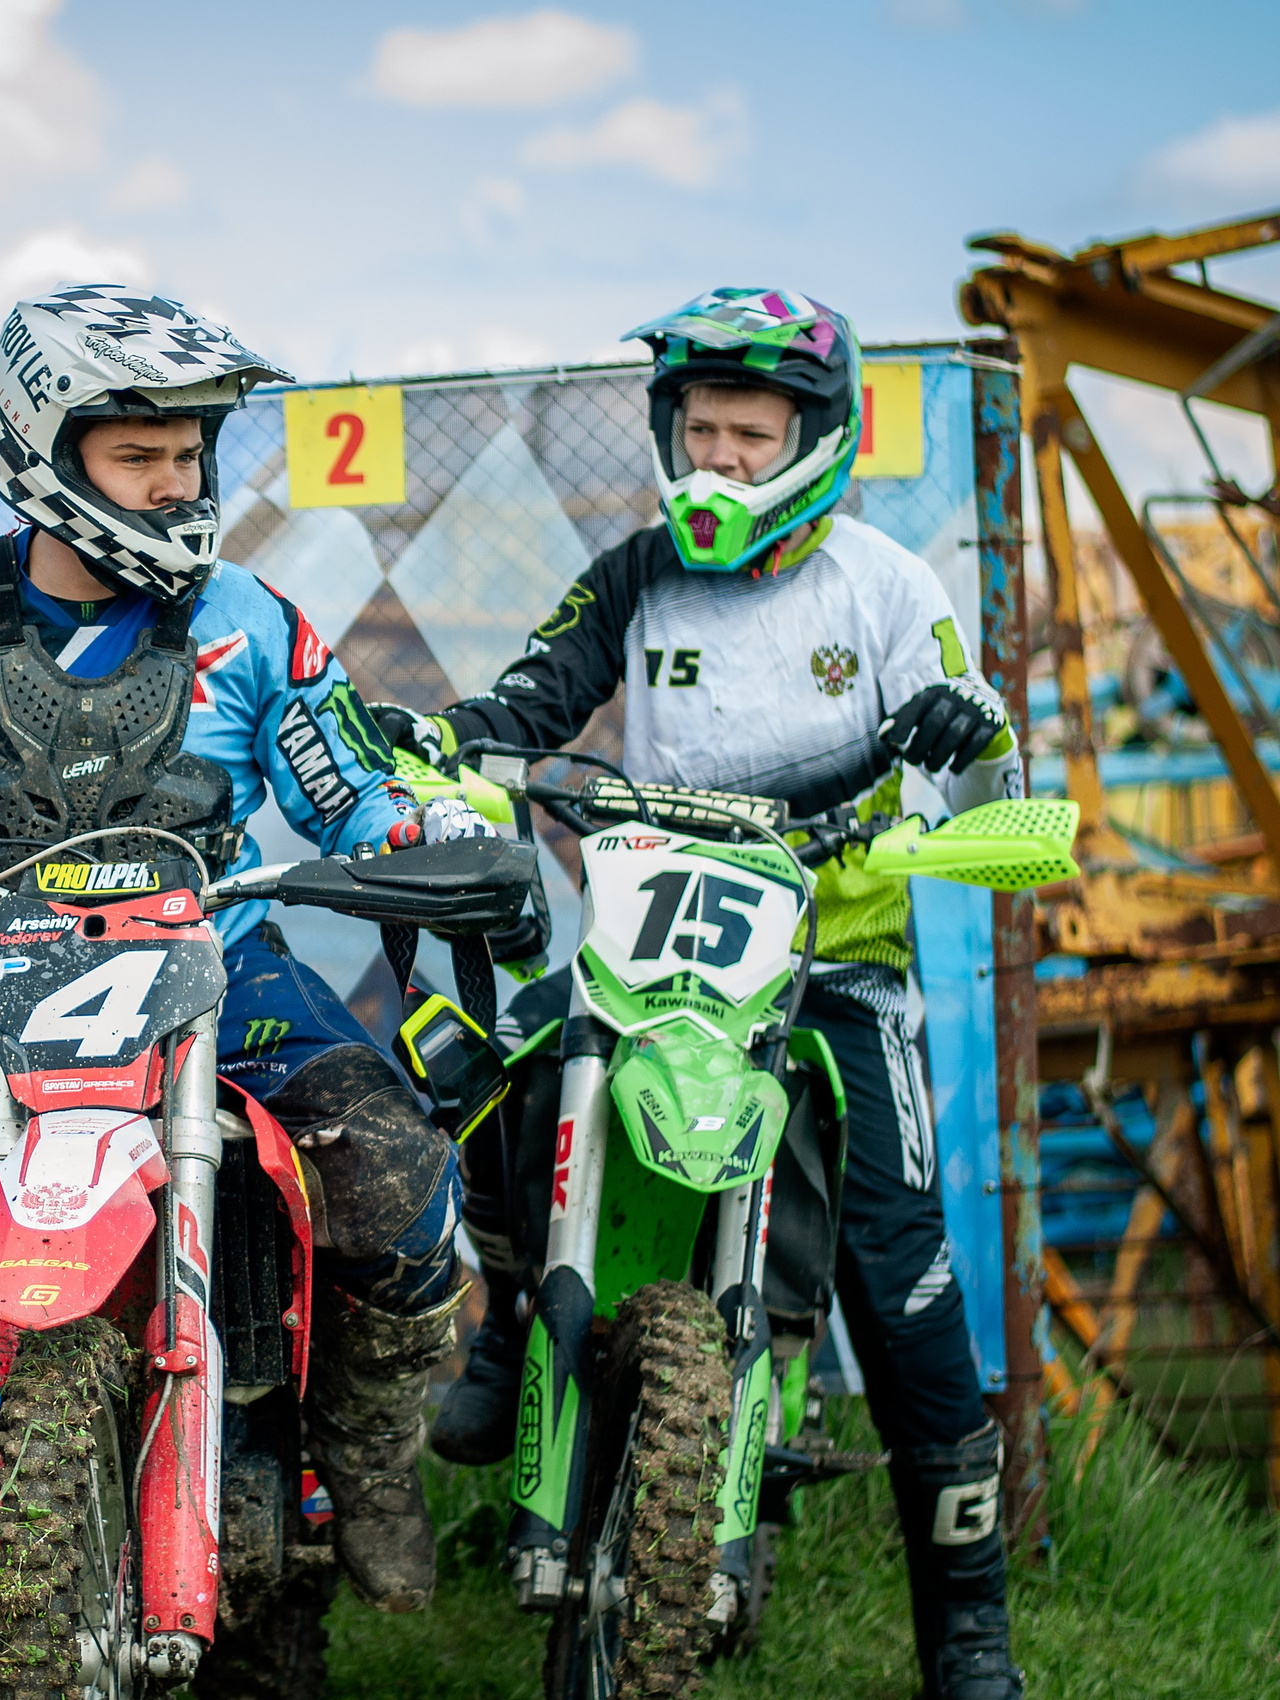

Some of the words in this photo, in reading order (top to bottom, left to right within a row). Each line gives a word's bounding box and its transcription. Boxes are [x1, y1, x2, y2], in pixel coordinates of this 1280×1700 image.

[325, 412, 366, 485] 2
[644, 648, 701, 688] 15
[62, 755, 110, 779] LEATT
[597, 836, 671, 851] MXGP
[629, 870, 765, 969] 15
[19, 949, 169, 1058] 4
[644, 993, 726, 1020] Kawasaki
[43, 1080, 81, 1092] SPYSTAV
[83, 1080, 135, 1088] GRAPHICS
[658, 1150, 750, 1171] Kawasaki
